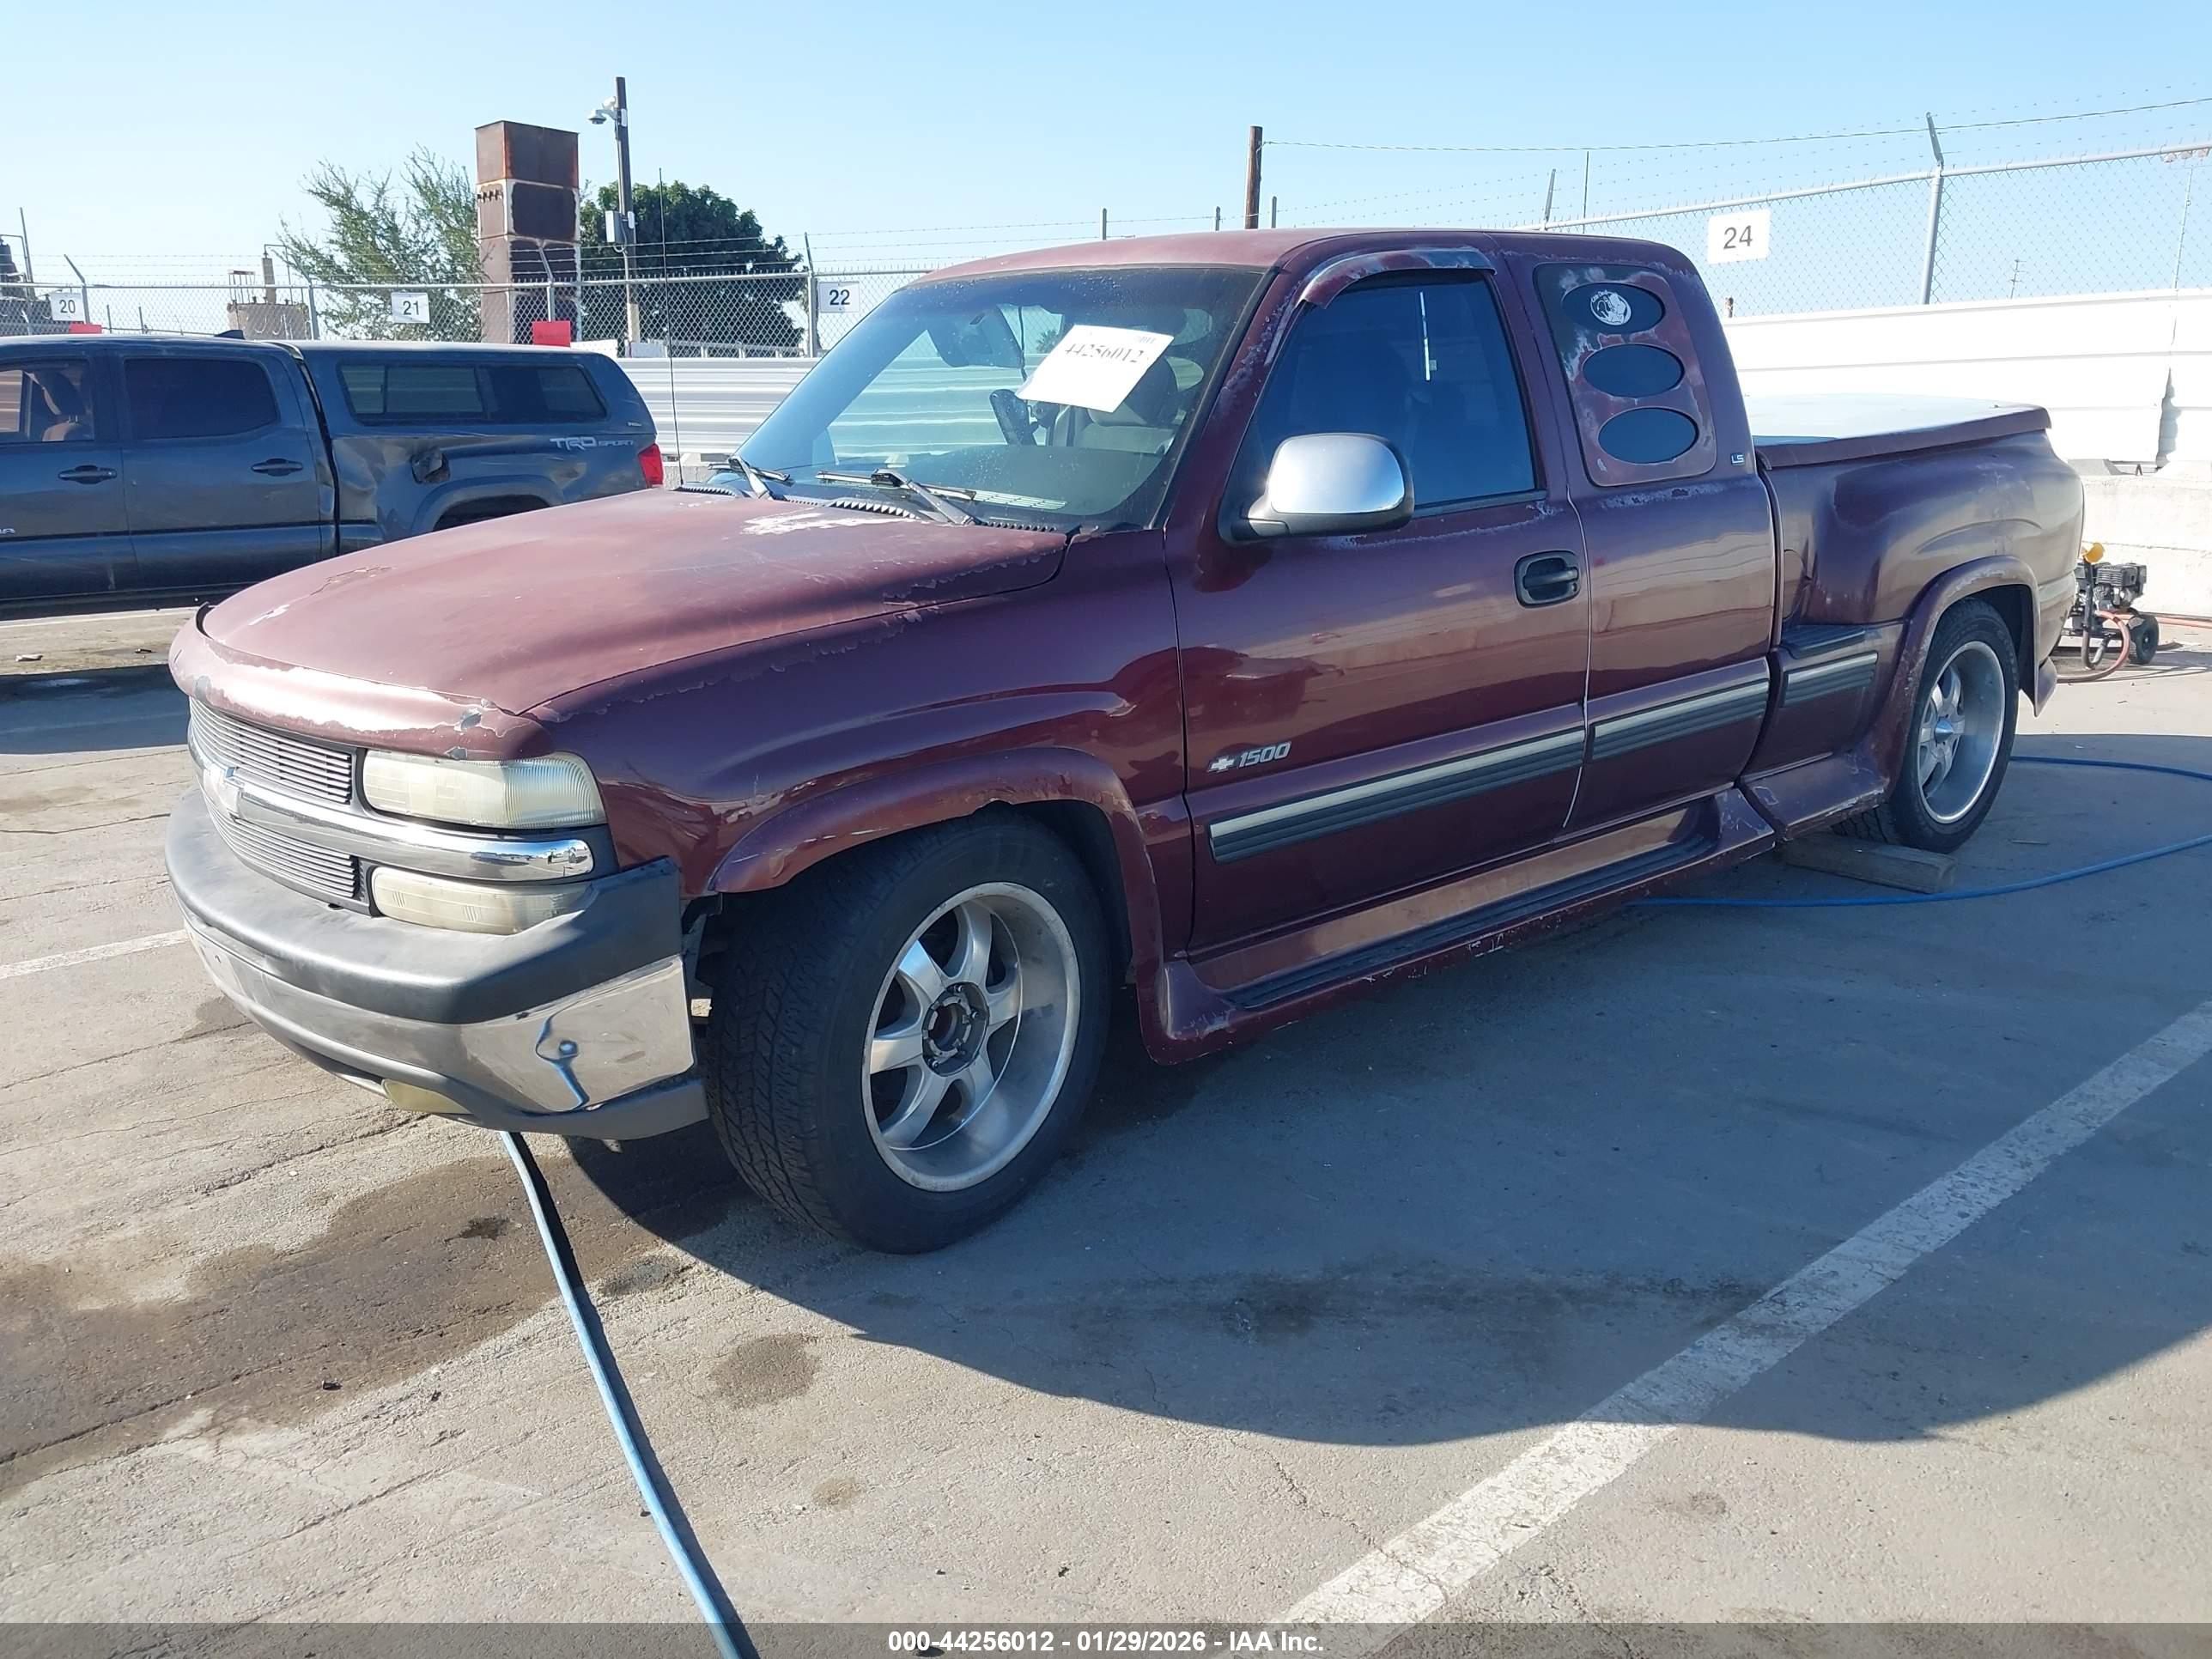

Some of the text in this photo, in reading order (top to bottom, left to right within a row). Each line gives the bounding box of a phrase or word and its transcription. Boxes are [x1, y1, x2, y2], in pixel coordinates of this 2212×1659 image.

[1723, 225, 1753, 249] 24
[829, 289, 850, 306] 22
[59, 299, 76, 313] 20
[403, 301, 419, 315] 21
[550, 436, 597, 451] TRD
[1731, 454, 1744, 464] LS
[1238, 741, 1291, 768] 1500
